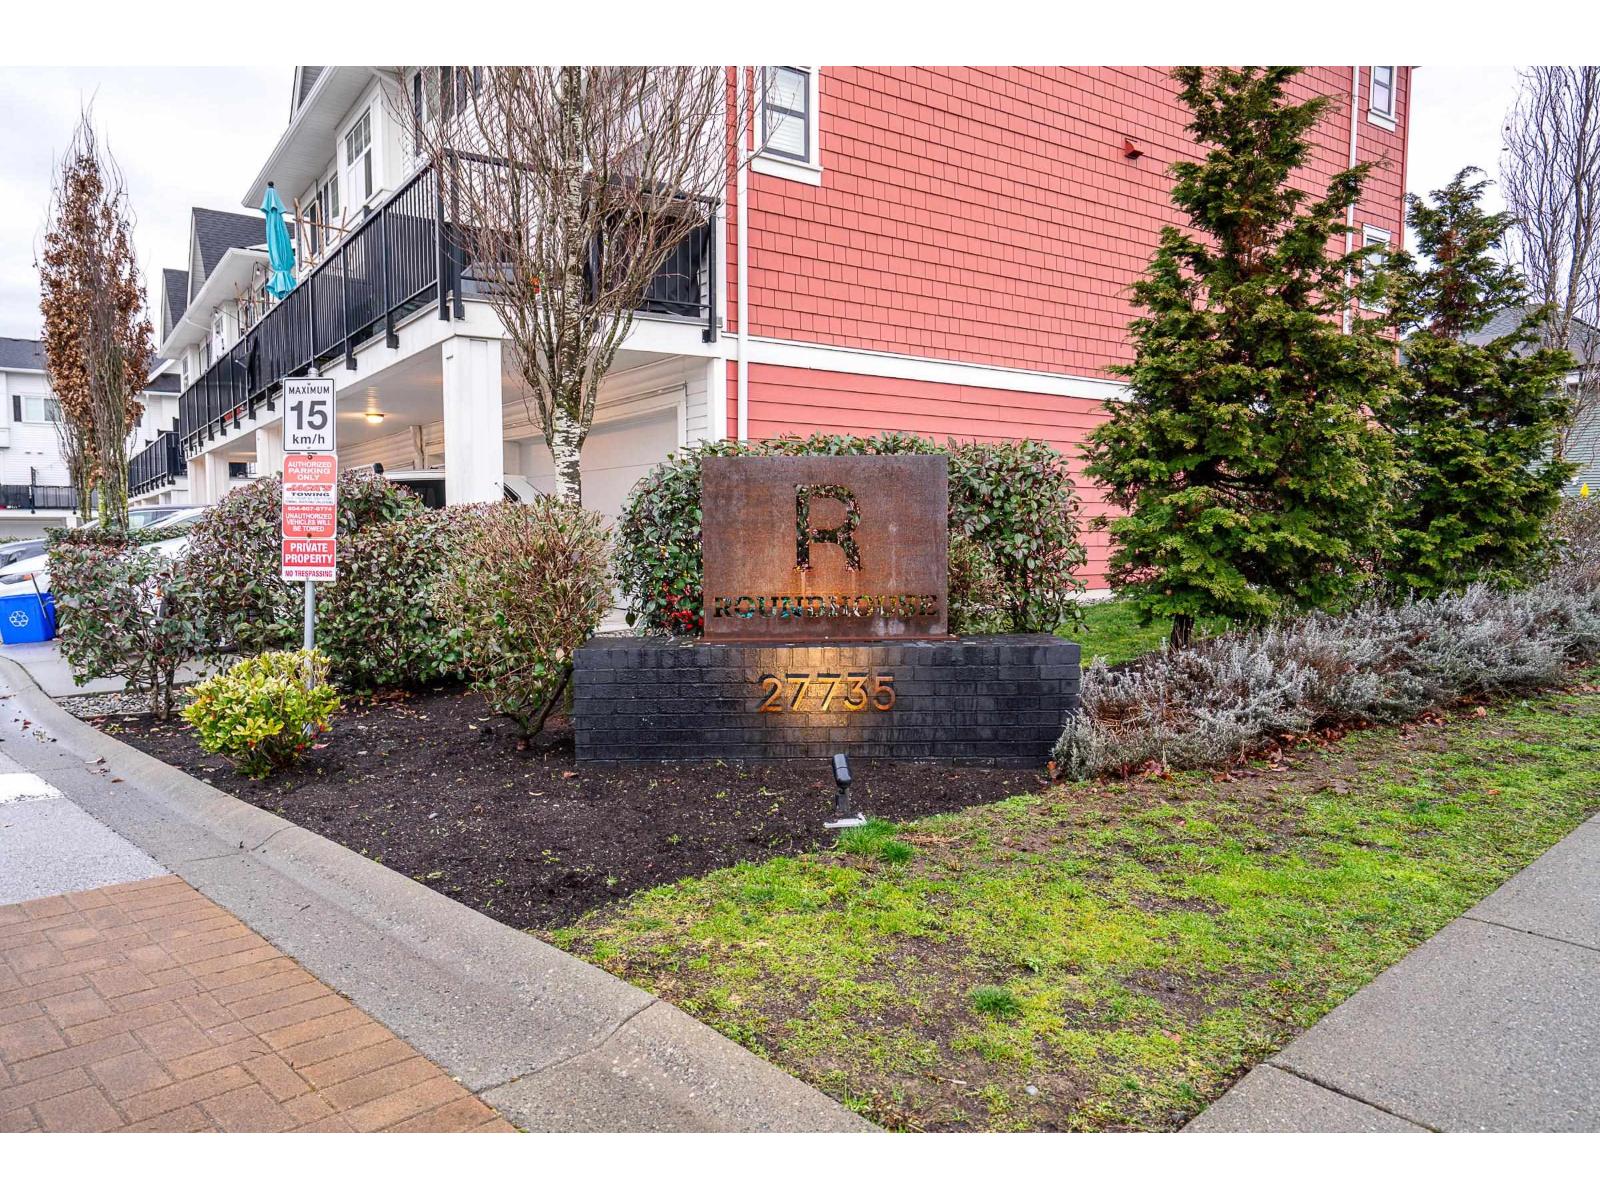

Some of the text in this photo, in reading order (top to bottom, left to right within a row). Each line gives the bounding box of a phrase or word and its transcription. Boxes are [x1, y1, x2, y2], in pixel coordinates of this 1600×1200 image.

[288, 386, 330, 394] MAXIMUM
[290, 400, 328, 430] 15
[292, 433, 325, 444] km/h
[793, 484, 863, 572] R
[290, 543, 328, 553] PRIVATE
[285, 554, 333, 564] PROPERTY
[294, 570, 333, 578] TRESPASSING
[713, 594, 938, 618] ROUNDHOUSE
[759, 673, 896, 711] 27735
